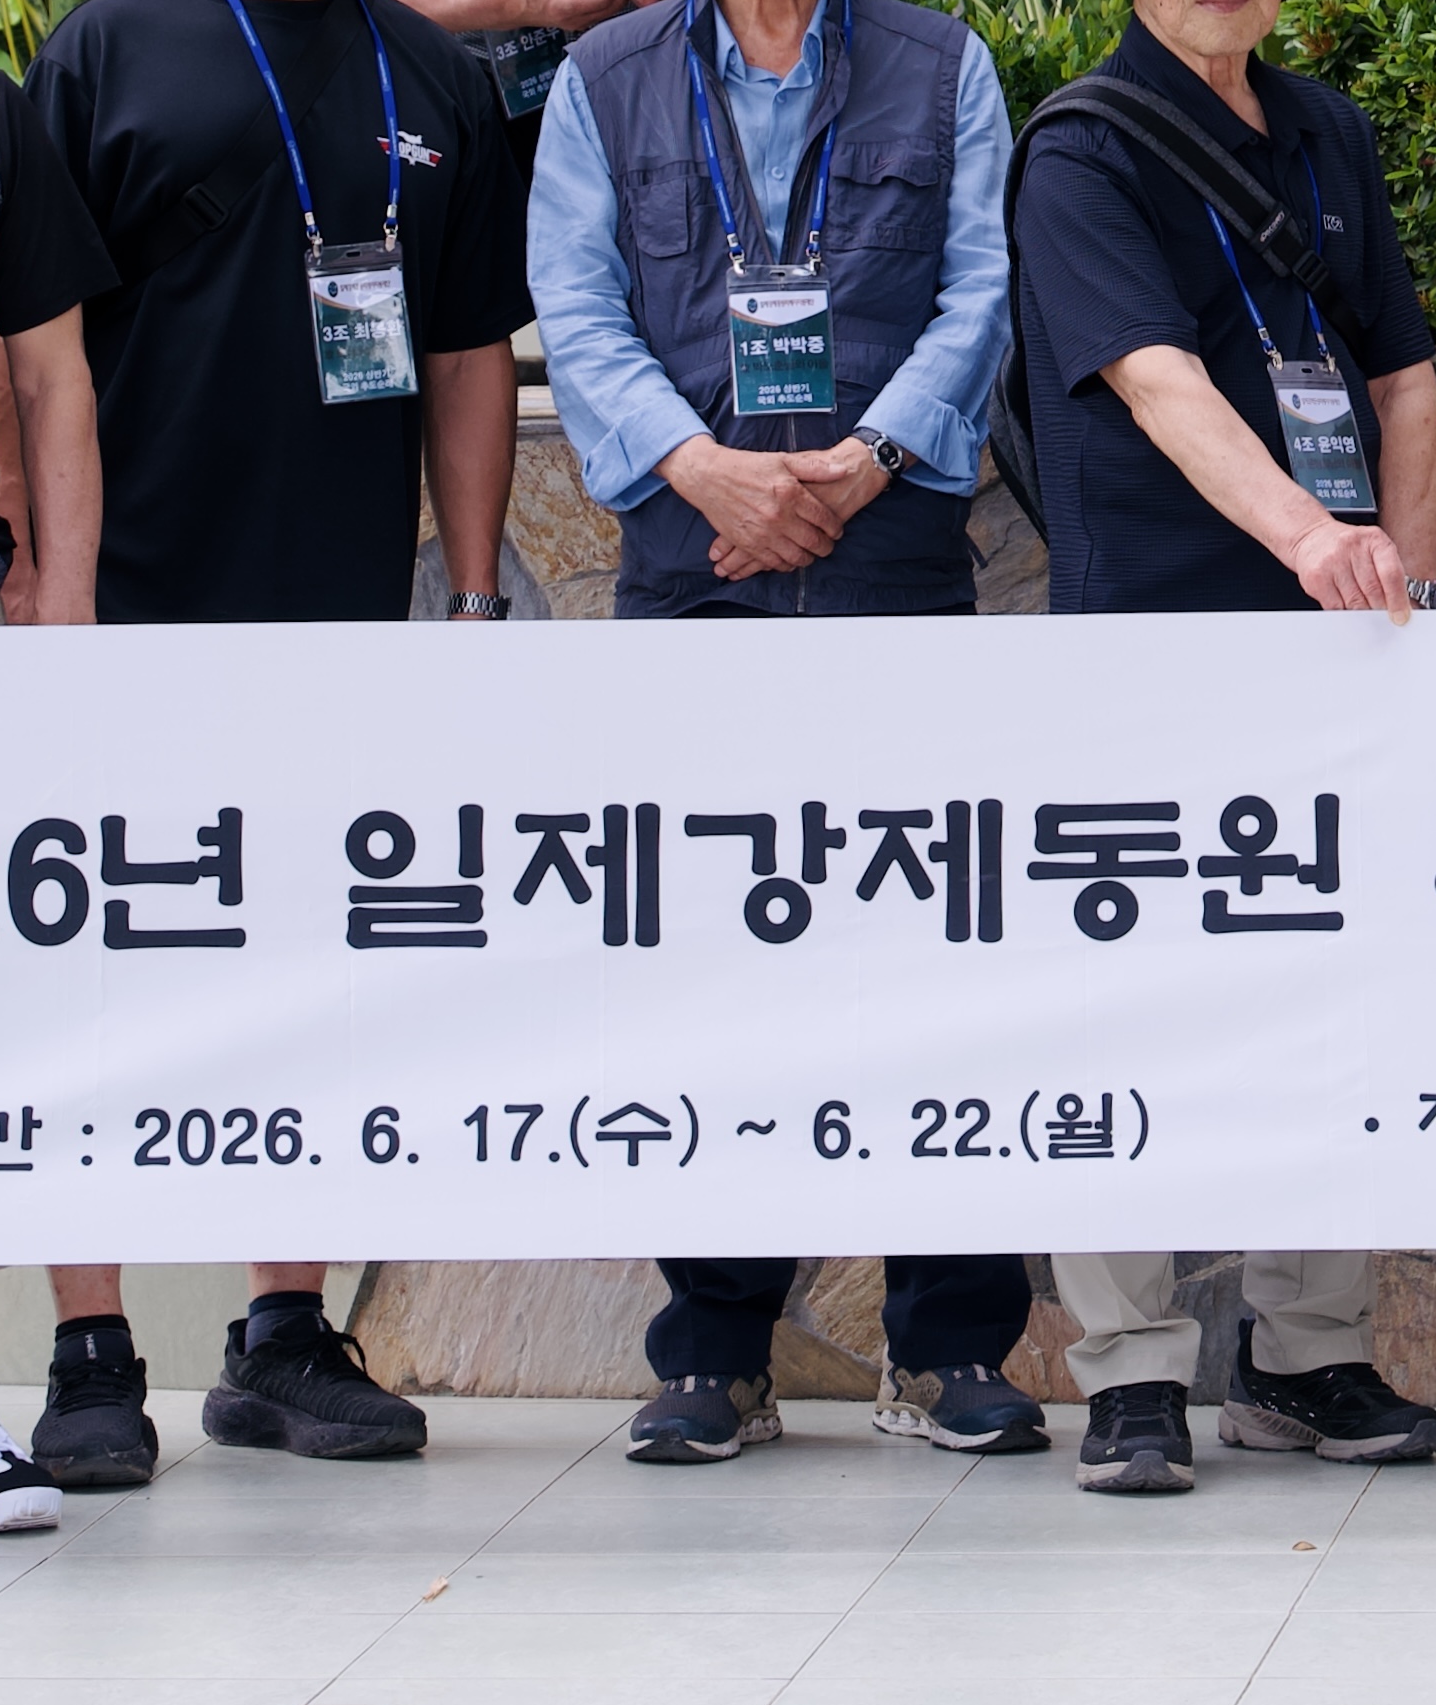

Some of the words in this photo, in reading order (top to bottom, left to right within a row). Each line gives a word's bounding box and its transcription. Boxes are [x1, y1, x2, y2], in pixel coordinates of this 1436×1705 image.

[495, 40, 519, 61] 3조
[1323, 213, 1344, 233] K2
[323, 324, 350, 343] 3조
[739, 339, 769, 356] 1조
[758, 385, 781, 395] 2026
[783, 382, 810, 394] 상반기
[1293, 435, 1315, 452] 4조
[1318, 434, 1357, 454] 윤익영
[344, 793, 1344, 950] 일제강제동원
[134, 1107, 322, 1167] 2026.
[361, 1105, 419, 1164] 6.
[463, 1094, 699, 1168] 17.(수)
[813, 1100, 871, 1160] 6.
[911, 1088, 1149, 1163] 22.(월)
